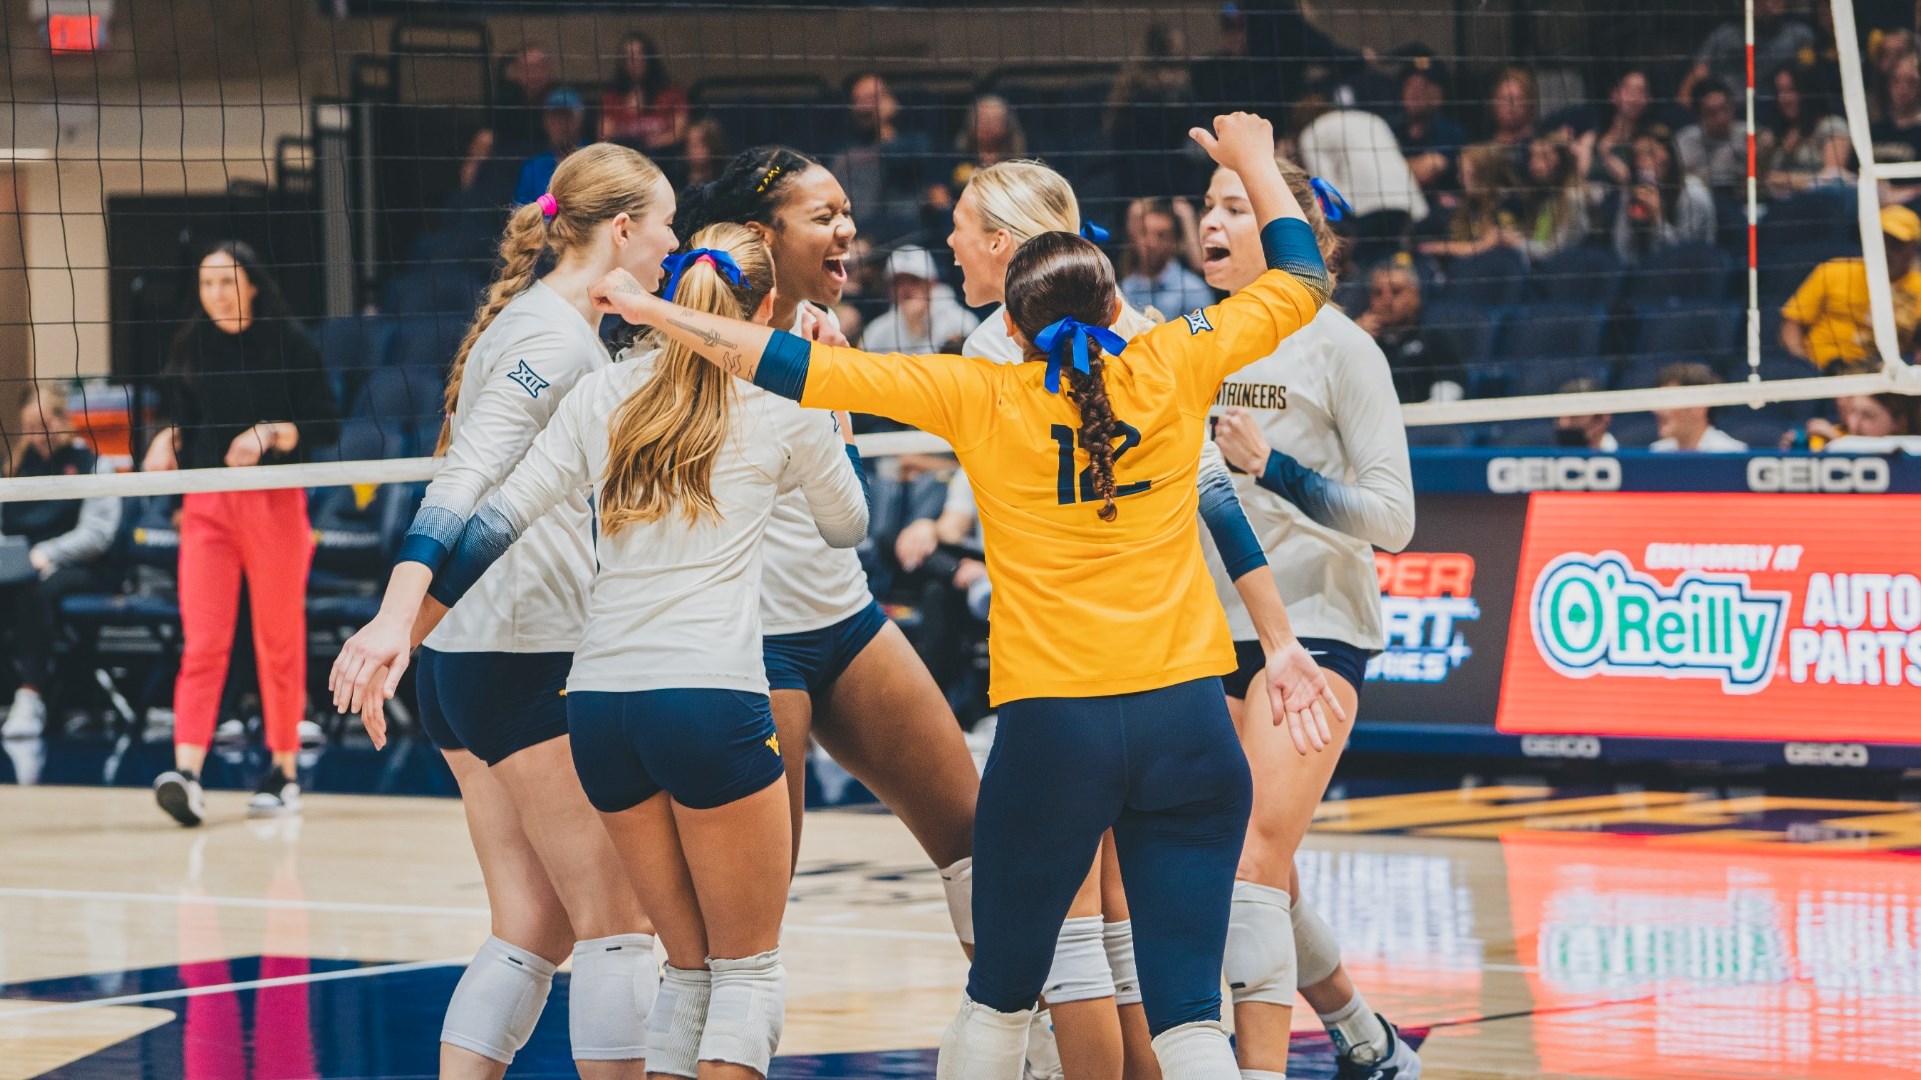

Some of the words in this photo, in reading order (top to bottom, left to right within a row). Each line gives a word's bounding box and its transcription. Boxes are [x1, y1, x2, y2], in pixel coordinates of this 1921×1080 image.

[1050, 420, 1152, 505] 12
[1487, 456, 1622, 493] GEICO
[1747, 456, 1890, 493] GEICO
[1772, 544, 1804, 571] AT
[1803, 572, 1921, 631] AUTO
[1547, 572, 1768, 671] O'Reilly
[1789, 629, 1921, 687] PARTS
[1521, 734, 1601, 759] GEICO
[1784, 742, 1868, 767] GEICO
